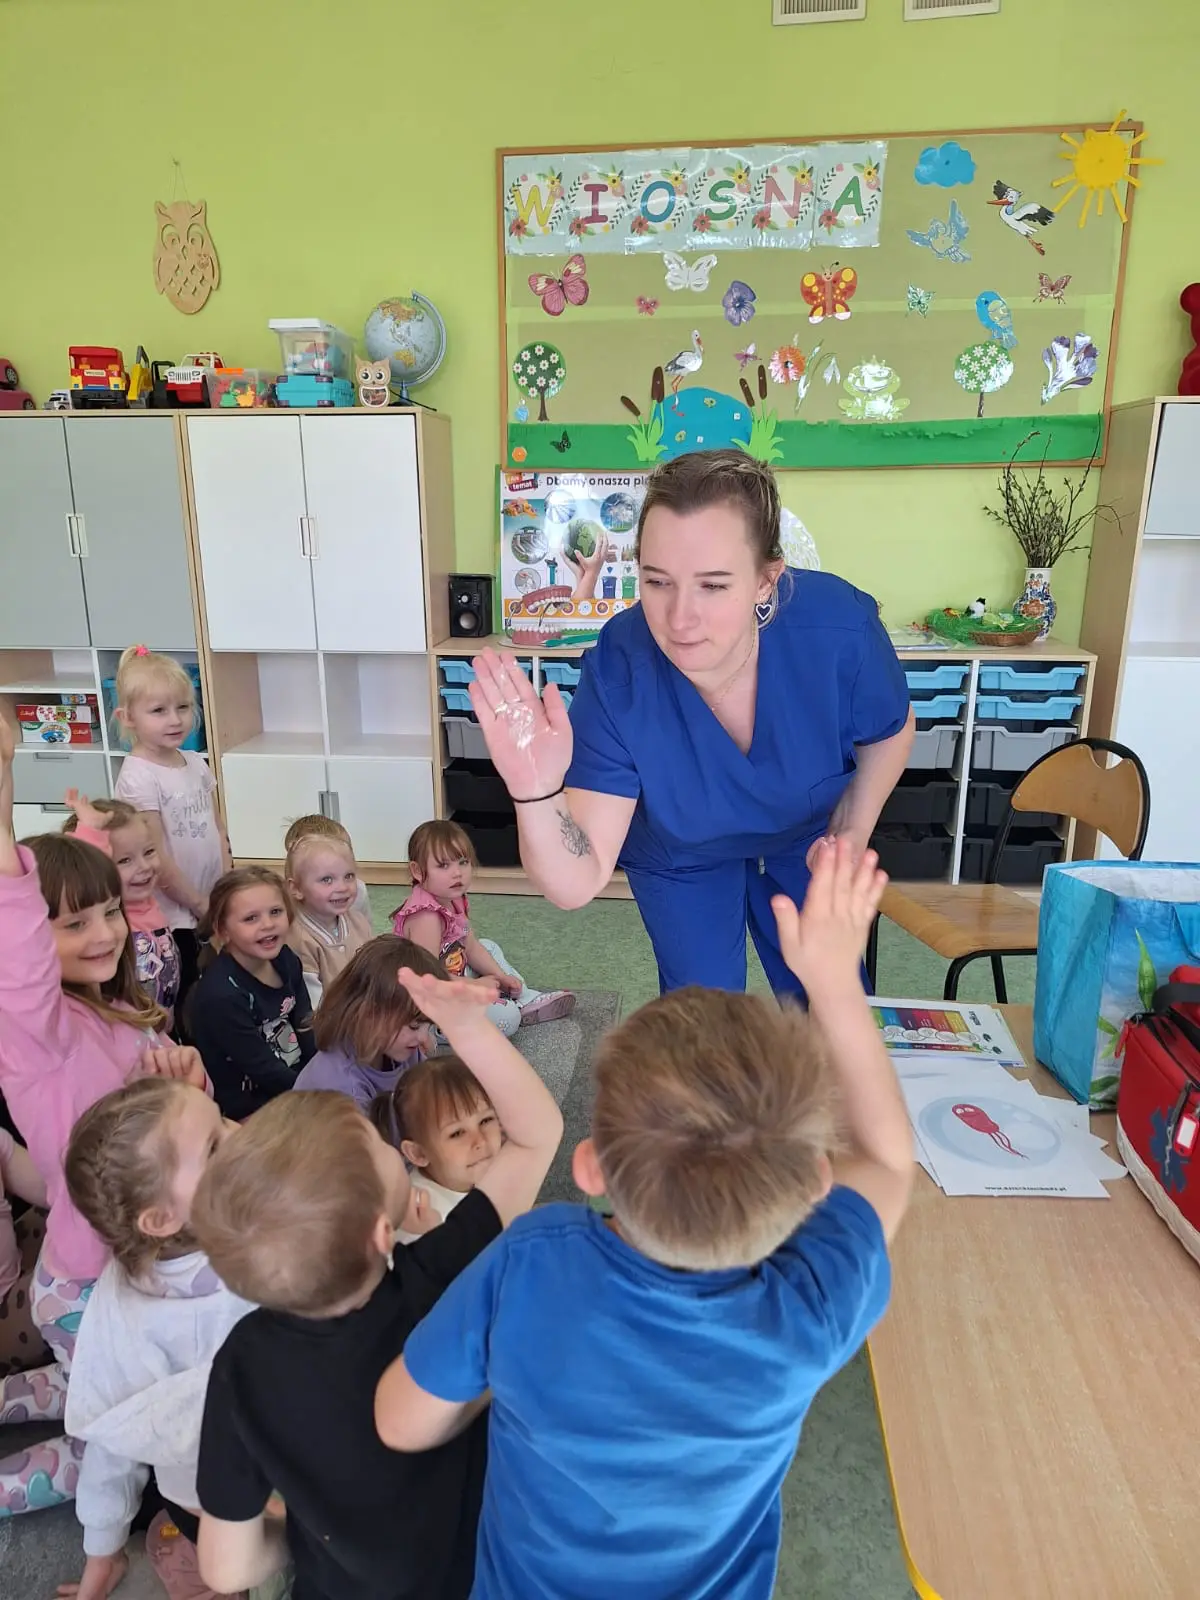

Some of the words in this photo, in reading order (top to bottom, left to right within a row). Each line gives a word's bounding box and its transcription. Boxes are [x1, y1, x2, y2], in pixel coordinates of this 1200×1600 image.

[513, 175, 865, 227] WIOSNA
[546, 476, 586, 488] Dbamy
[589, 477, 597, 486] o
[597, 477, 630, 488] naszą
